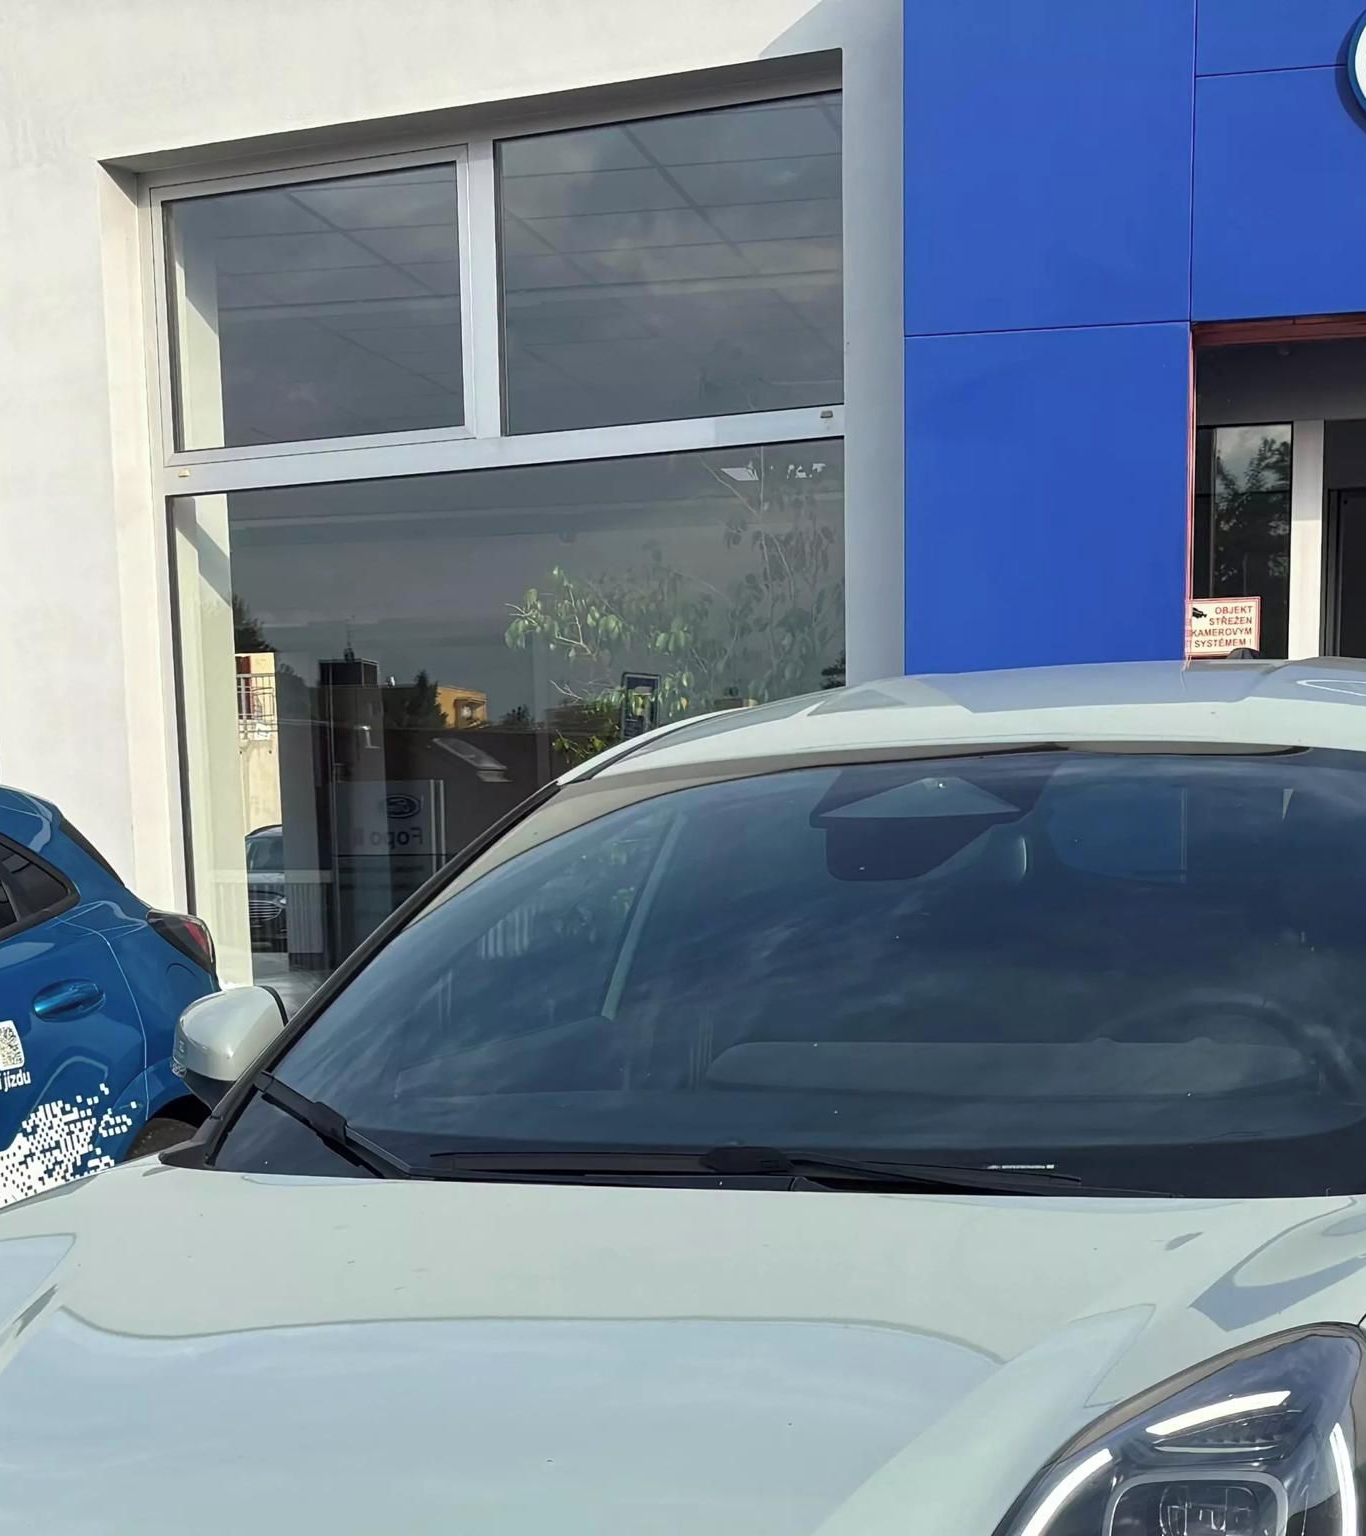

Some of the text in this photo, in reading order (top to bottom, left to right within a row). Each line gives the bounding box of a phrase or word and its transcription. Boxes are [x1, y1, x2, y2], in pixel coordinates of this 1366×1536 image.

[1214, 605, 1253, 615] OBJEKT
[1209, 615, 1252, 626] STŘEŽEN
[1194, 637, 1246, 648] SYSTÉMEM
[2, 1069, 31, 1092] jízdu
